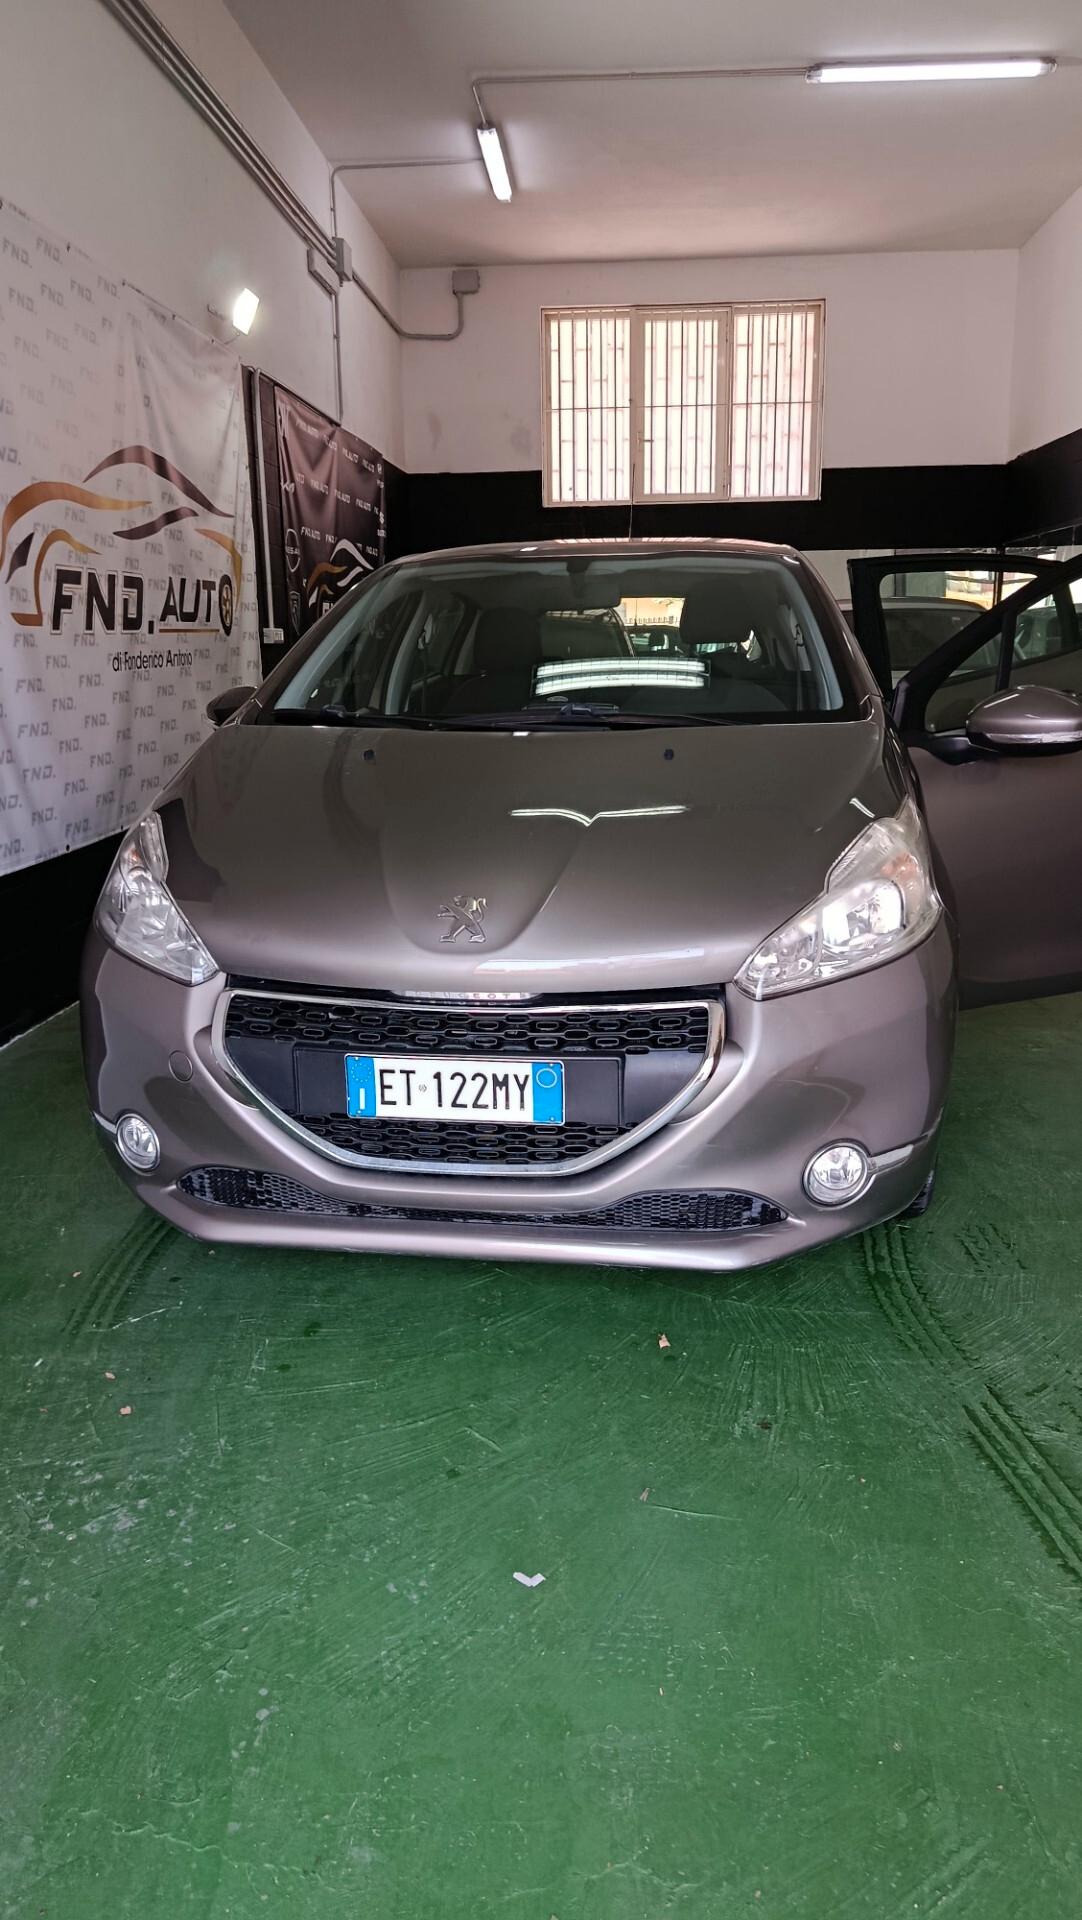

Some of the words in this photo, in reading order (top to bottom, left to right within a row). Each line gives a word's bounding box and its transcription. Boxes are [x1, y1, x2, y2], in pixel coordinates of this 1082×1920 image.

[13, 632, 38, 648] FND.
[73, 632, 99, 648] FND.
[46, 653, 71, 670] FND.
[112, 651, 123, 672] di
[165, 648, 193, 667] Antonio
[78, 673, 105, 688] FND.
[156, 684, 177, 698] FND.
[51, 696, 77, 712] FND.
[134, 704, 156, 719] FND.
[83, 712, 110, 728] FND.
[17, 721, 52, 738] FND.
[59, 737, 82, 754] FND.
[89, 752, 114, 768] FND.
[22, 765, 56, 784] FND.
[64, 778, 89, 796] FND.
[31, 807, 58, 827] FND.
[379, 1069, 416, 1106] ET
[433, 1071, 530, 1110] 122MY
[359, 1088, 365, 1109] I
